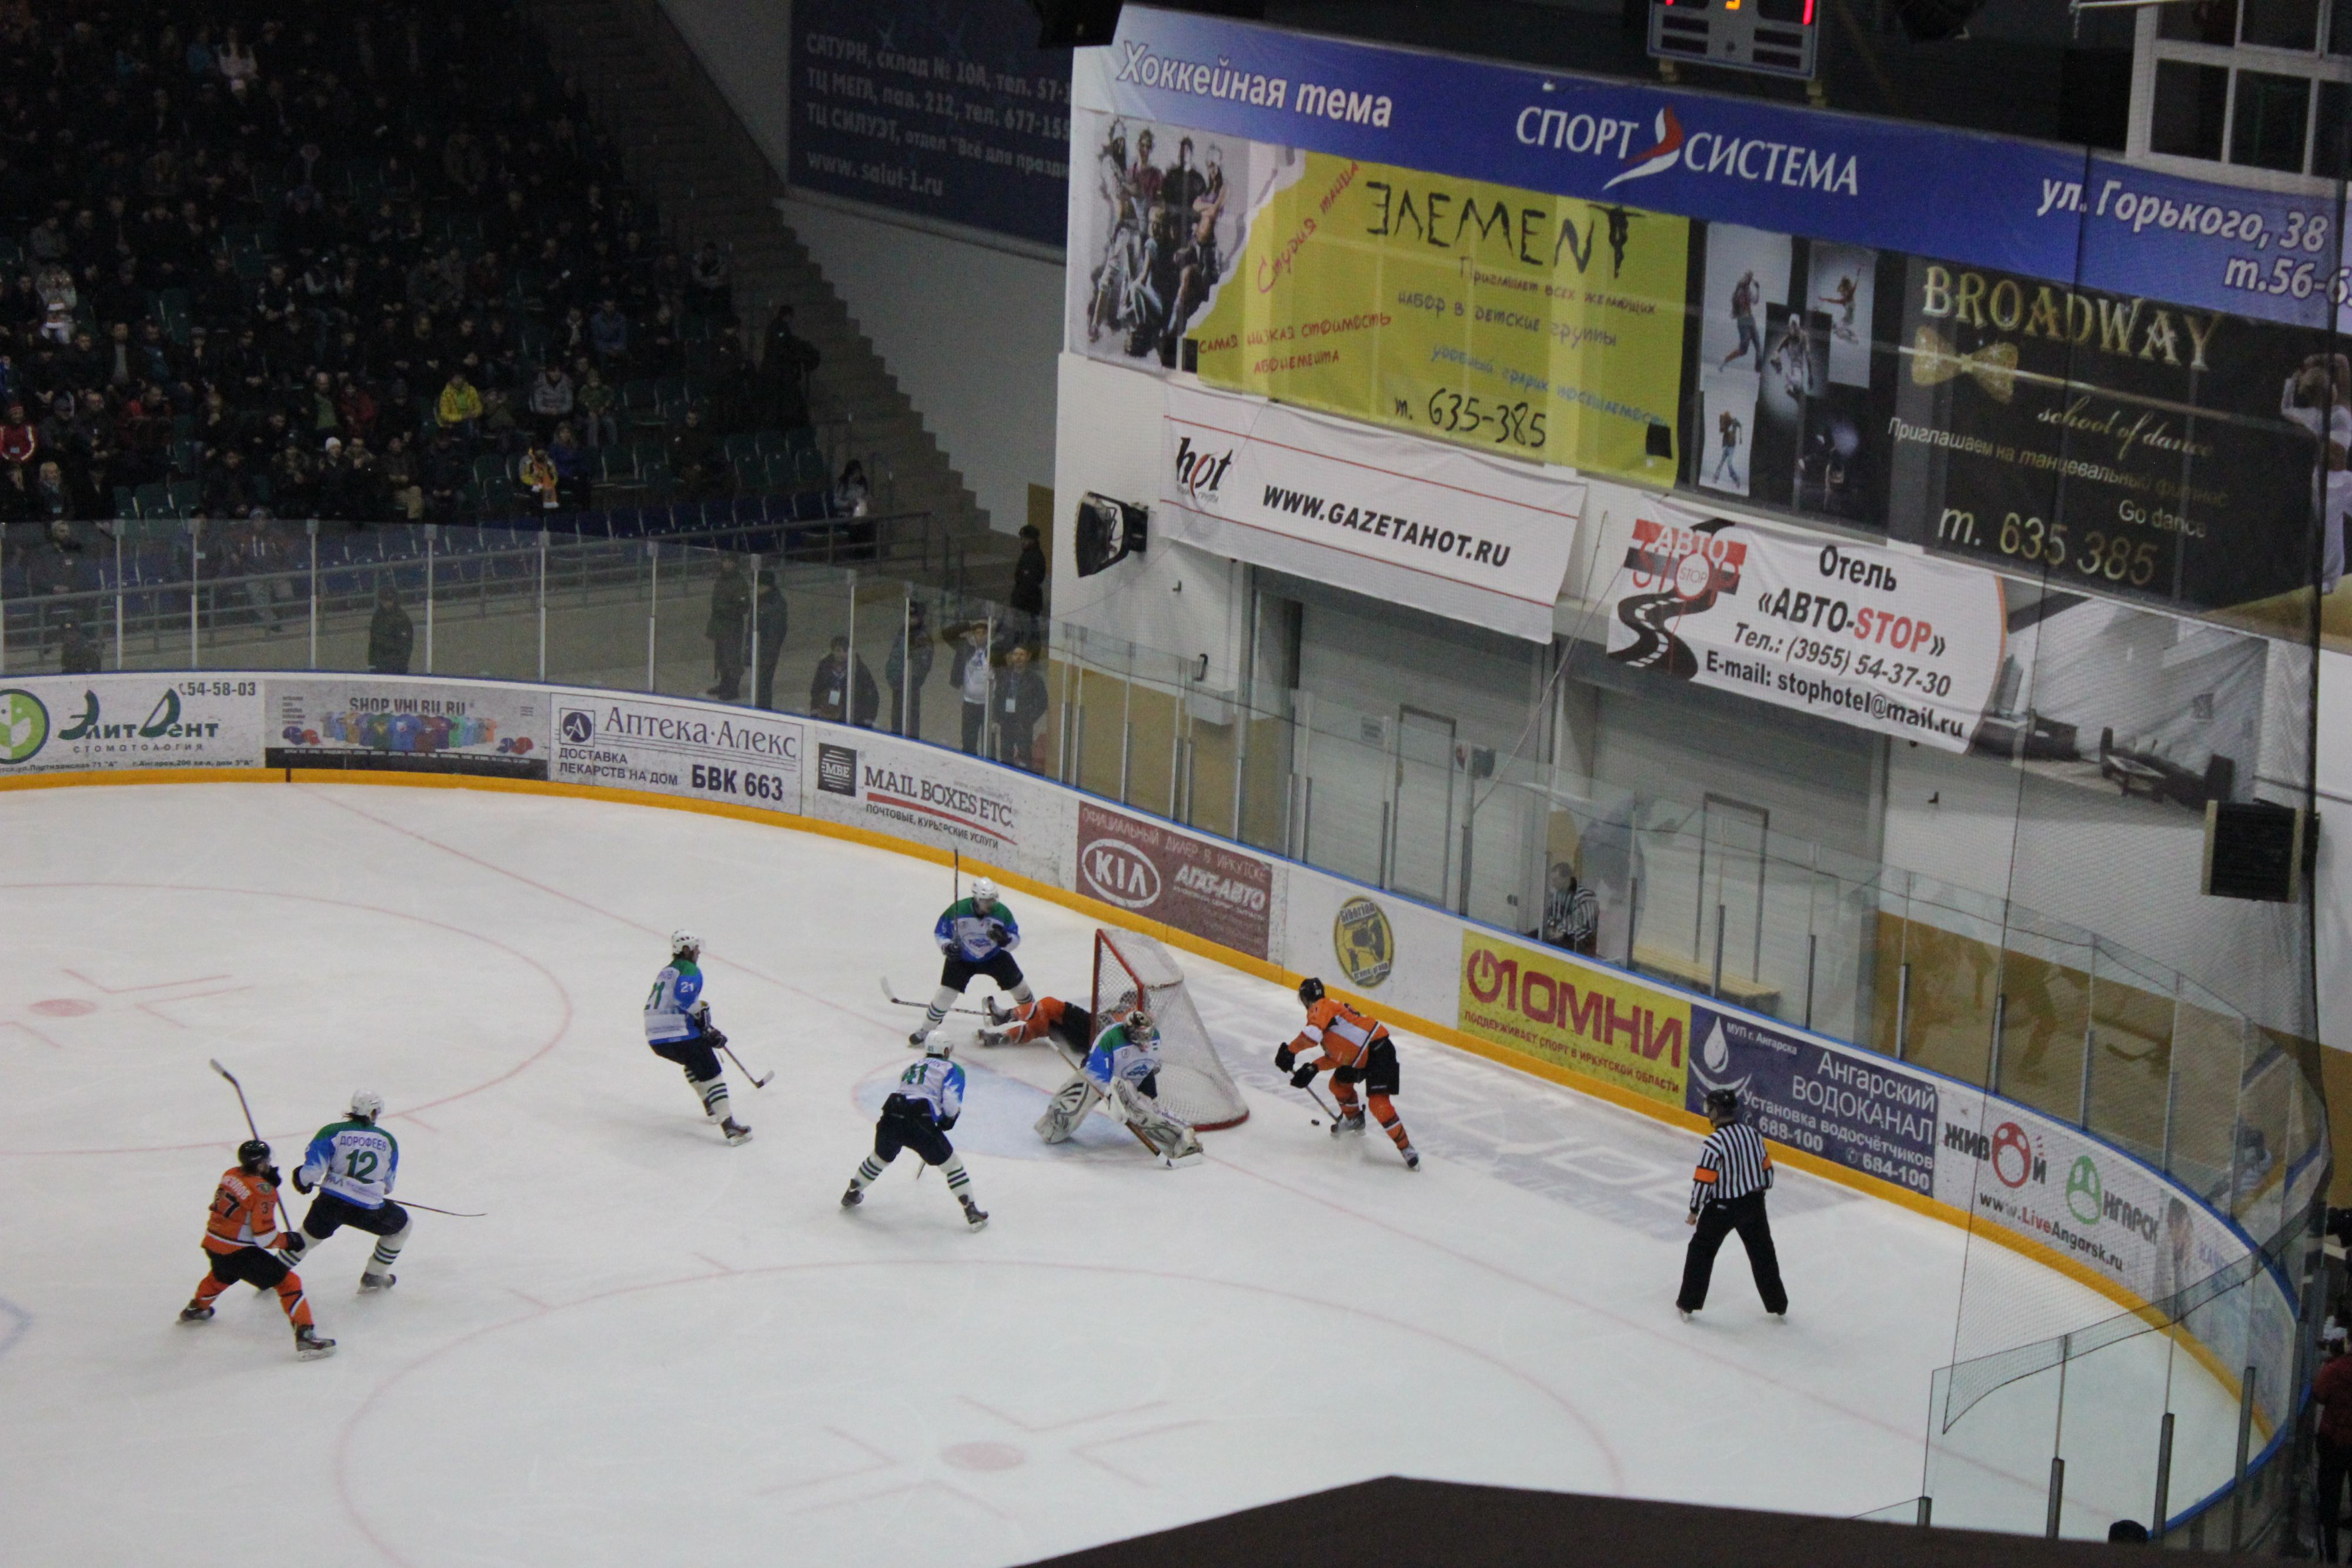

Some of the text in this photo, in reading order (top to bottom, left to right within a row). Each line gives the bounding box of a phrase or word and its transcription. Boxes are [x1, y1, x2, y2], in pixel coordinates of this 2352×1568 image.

[1117, 41, 1393, 128] Хоккейная тема
[1515, 106, 1639, 159] СПОРТ
[1685, 131, 1859, 196] СИСТЕМА
[2279, 210, 2330, 253] 38
[1922, 265, 2225, 371] BROADWAY
[1428, 387, 1547, 447] 635-385
[2037, 396, 2120, 435] school
[1888, 416, 1993, 457] Приглашаем
[1996, 443, 2016, 462] на
[1176, 437, 1234, 499] hot
[1262, 484, 1511, 568] WWW.GAZETAHOT.RU
[2118, 499, 2207, 539] Go dance
[1819, 545, 1897, 591] Отель
[1999, 512, 2068, 567] 635
[2077, 531, 2159, 586] 385
[1679, 566, 1708, 584] STOP
[1734, 623, 1952, 698] Тел.: (3955) 54-37-30
[187, 681, 256, 697] 54-58-03
[1706, 651, 1965, 738] E-mail: stophotel@mail.ru
[559, 747, 628, 764] ДОСТАВКА
[559, 762, 678, 786] ЛЕКАРСТВ НА ДОМ
[824, 763, 850, 779] MBE
[691, 764, 783, 801] БВК 663
[864, 765, 917, 798] MAIL
[920, 779, 978, 815] BOXES
[979, 797, 1014, 828] ETC.
[866, 804, 916, 825] ПОЧТОВЫЕ,
[970, 832, 998, 850] УСЛУГИ
[1082, 807, 1160, 845] ОФИЦИАЛЬНЫЙ
[1165, 836, 1199, 858] ДИЛЕР
[1095, 850, 1148, 898] KIA
[680, 981, 694, 993] 21
[1464, 1010, 1538, 1045] ПОДДЕРЖИВАЕТ
[1539, 1036, 1570, 1055] СПОРТ
[1635, 1069, 1679, 1094] ОБЛАСТИ
[1726, 1022, 1747, 1038] МУП
[1756, 1032, 1798, 1055] Ангарска
[1818, 1051, 1936, 1114] Ангарский
[1792, 1075, 1934, 1145] ВОДОКАНАЛ
[340, 1135, 387, 1152] ДОРОФЕЕВ
[1758, 1116, 1823, 1152] 688-100
[346, 1148, 378, 1184] 12
[1862, 1153, 1930, 1191] 684-100
[1979, 1192, 2124, 1273] www.LiveAngarsk.ru
